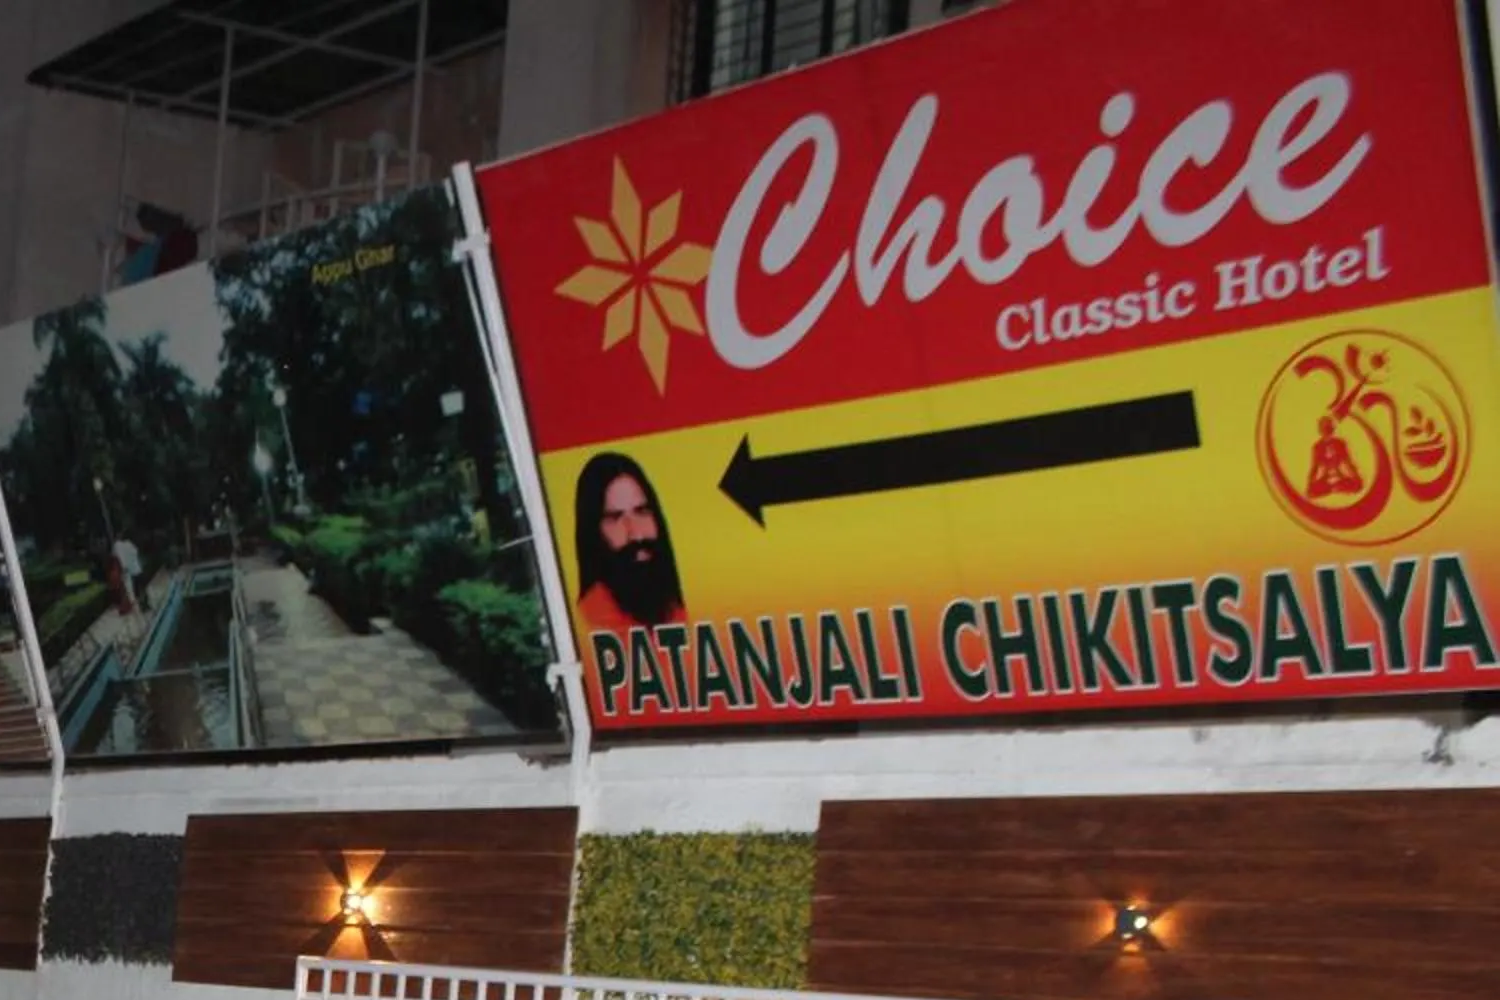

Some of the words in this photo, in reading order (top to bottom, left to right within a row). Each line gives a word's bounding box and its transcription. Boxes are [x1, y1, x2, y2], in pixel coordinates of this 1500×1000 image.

[706, 72, 1371, 369] Choice
[995, 276, 1197, 351] Classic
[1214, 229, 1389, 312] Hotel
[591, 606, 923, 716] PATANJALI
[940, 553, 1500, 701] CHIKITSALYA
